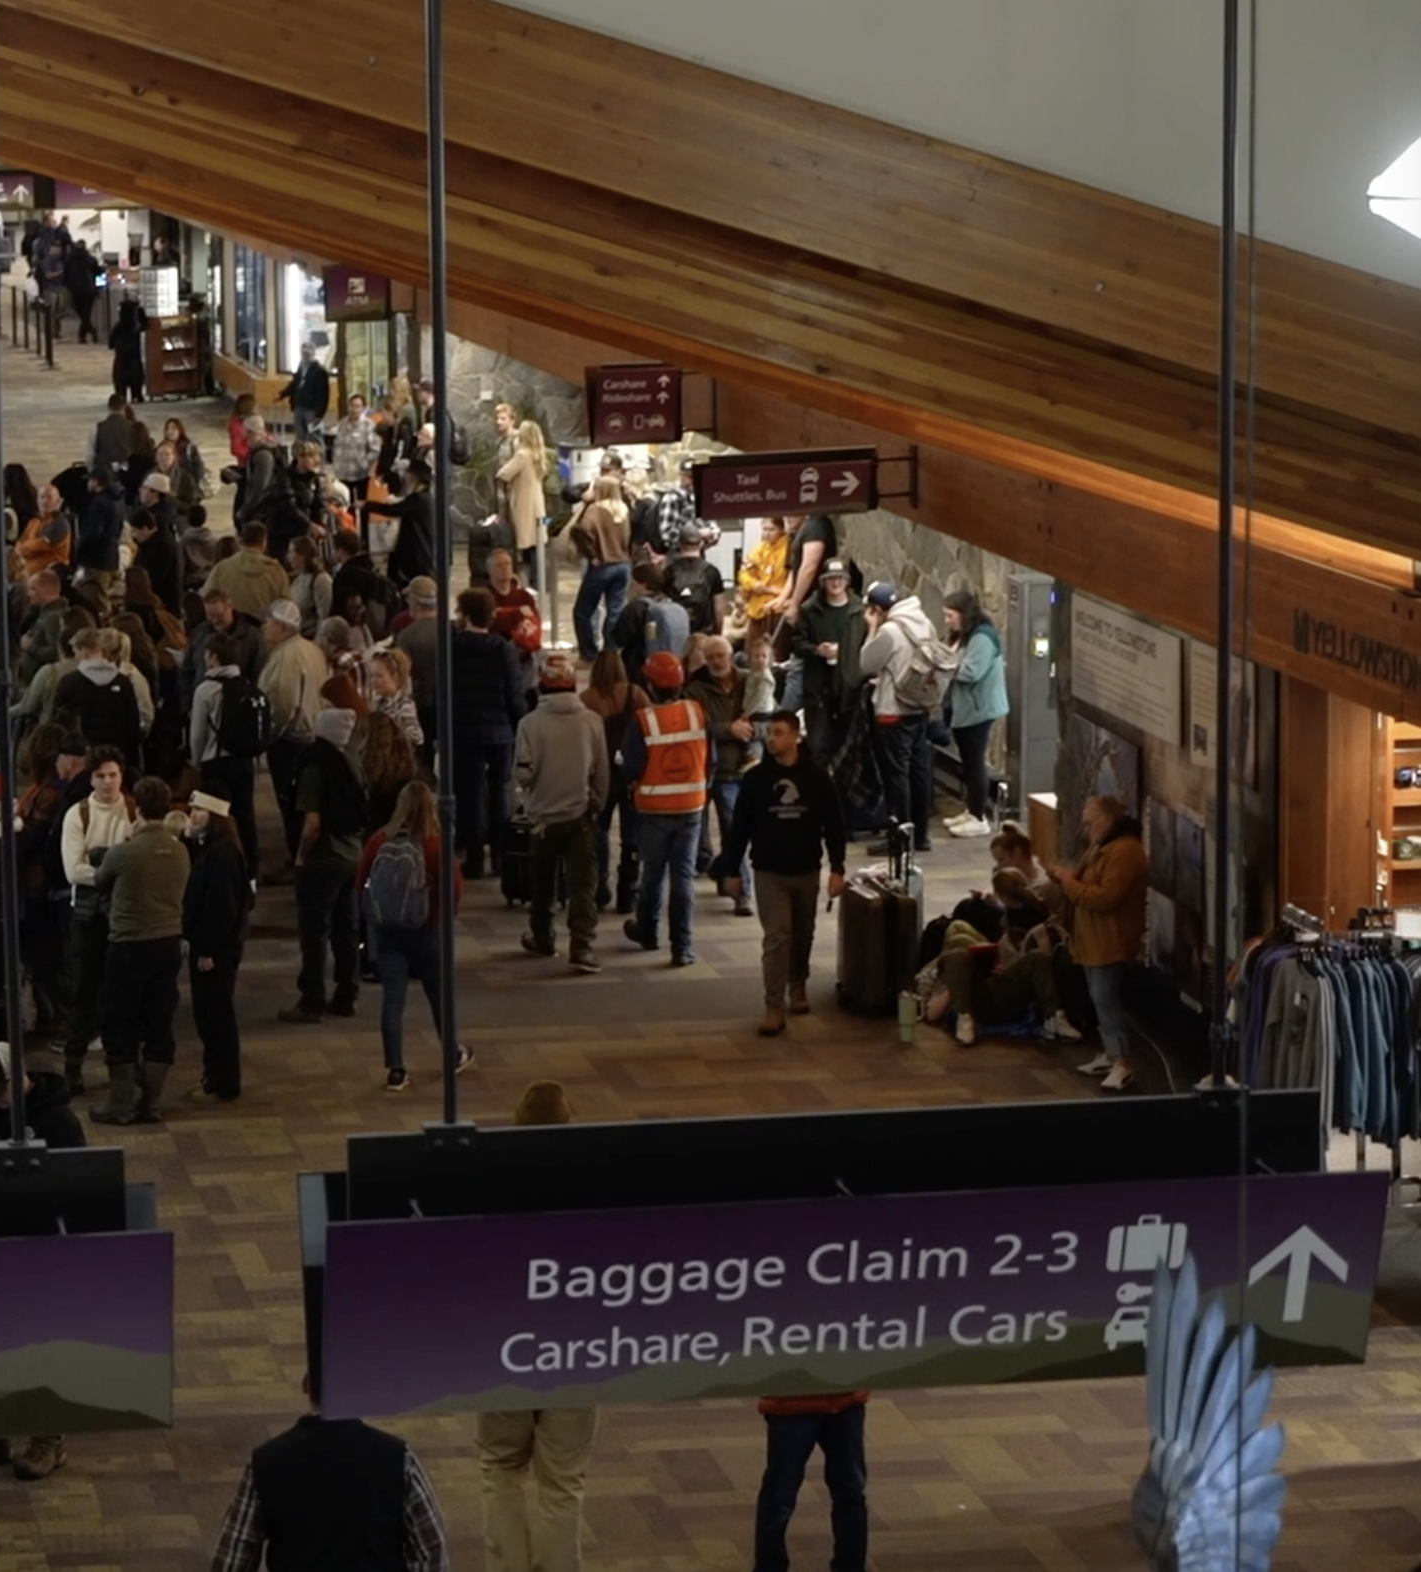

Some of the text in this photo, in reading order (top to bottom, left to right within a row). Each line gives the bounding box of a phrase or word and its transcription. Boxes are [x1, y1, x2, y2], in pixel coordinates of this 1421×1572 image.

[344, 296, 369, 306] ATM
[602, 379, 648, 391] Carshare
[602, 393, 652, 403] Rideshare
[736, 474, 759, 486] Taxi
[766, 489, 787, 501] Bus
[527, 1231, 1079, 1307] Baggage Claim 2-3
[500, 1305, 1068, 1372] Carshare, Rental Cars
